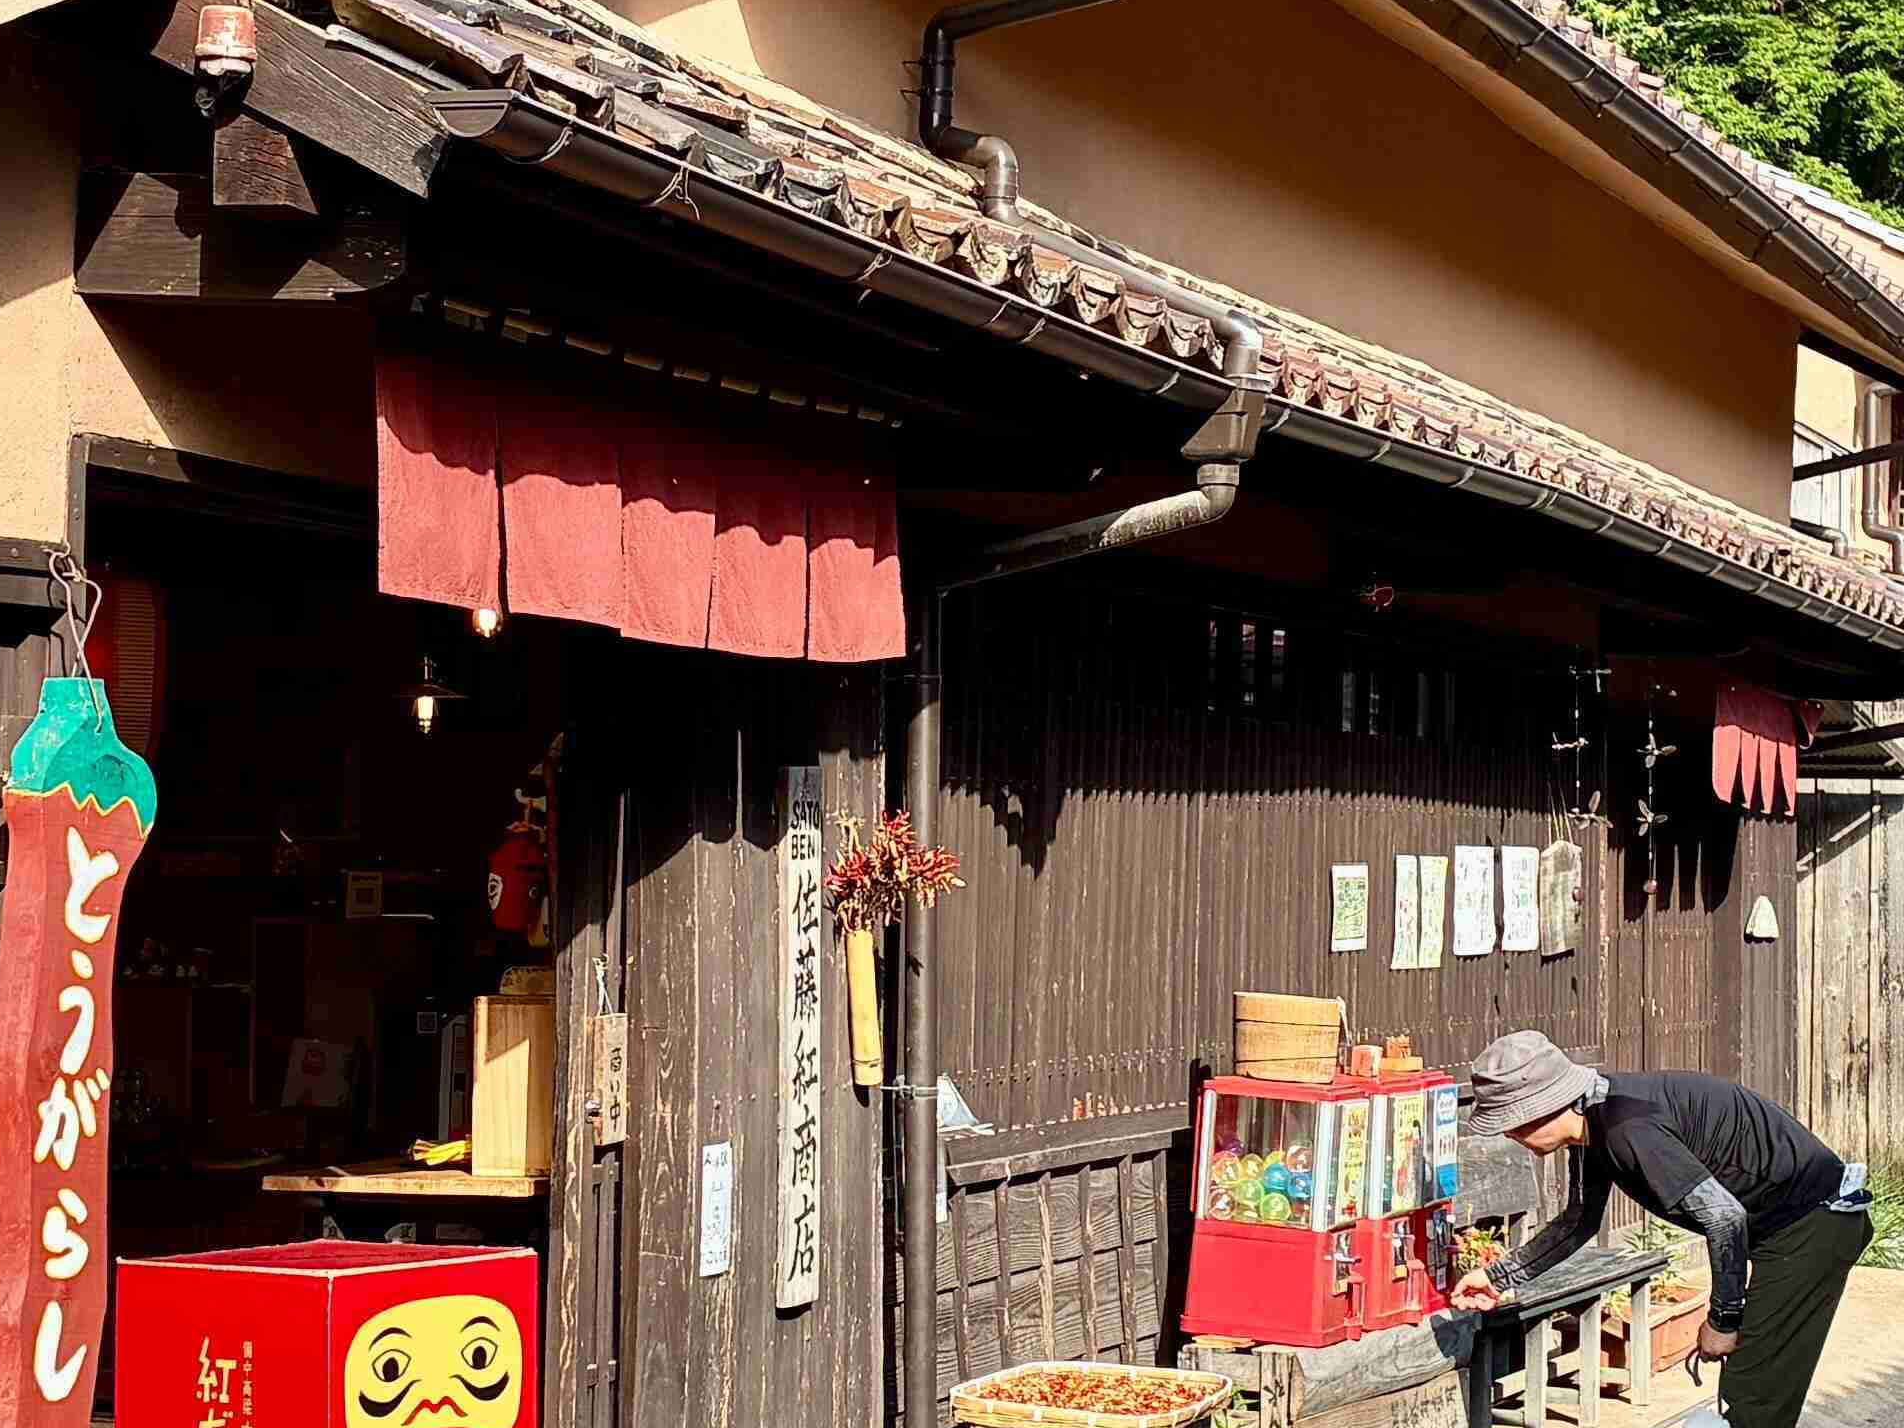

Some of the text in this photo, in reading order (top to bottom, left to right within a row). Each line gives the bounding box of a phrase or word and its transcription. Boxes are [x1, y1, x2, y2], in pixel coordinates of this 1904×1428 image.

[790, 801, 820, 830] SATO
[32, 824, 119, 1402] とうがらし
[609, 1047, 623, 1133] 商い中
[788, 873, 820, 1282] 佐藤紅商店
